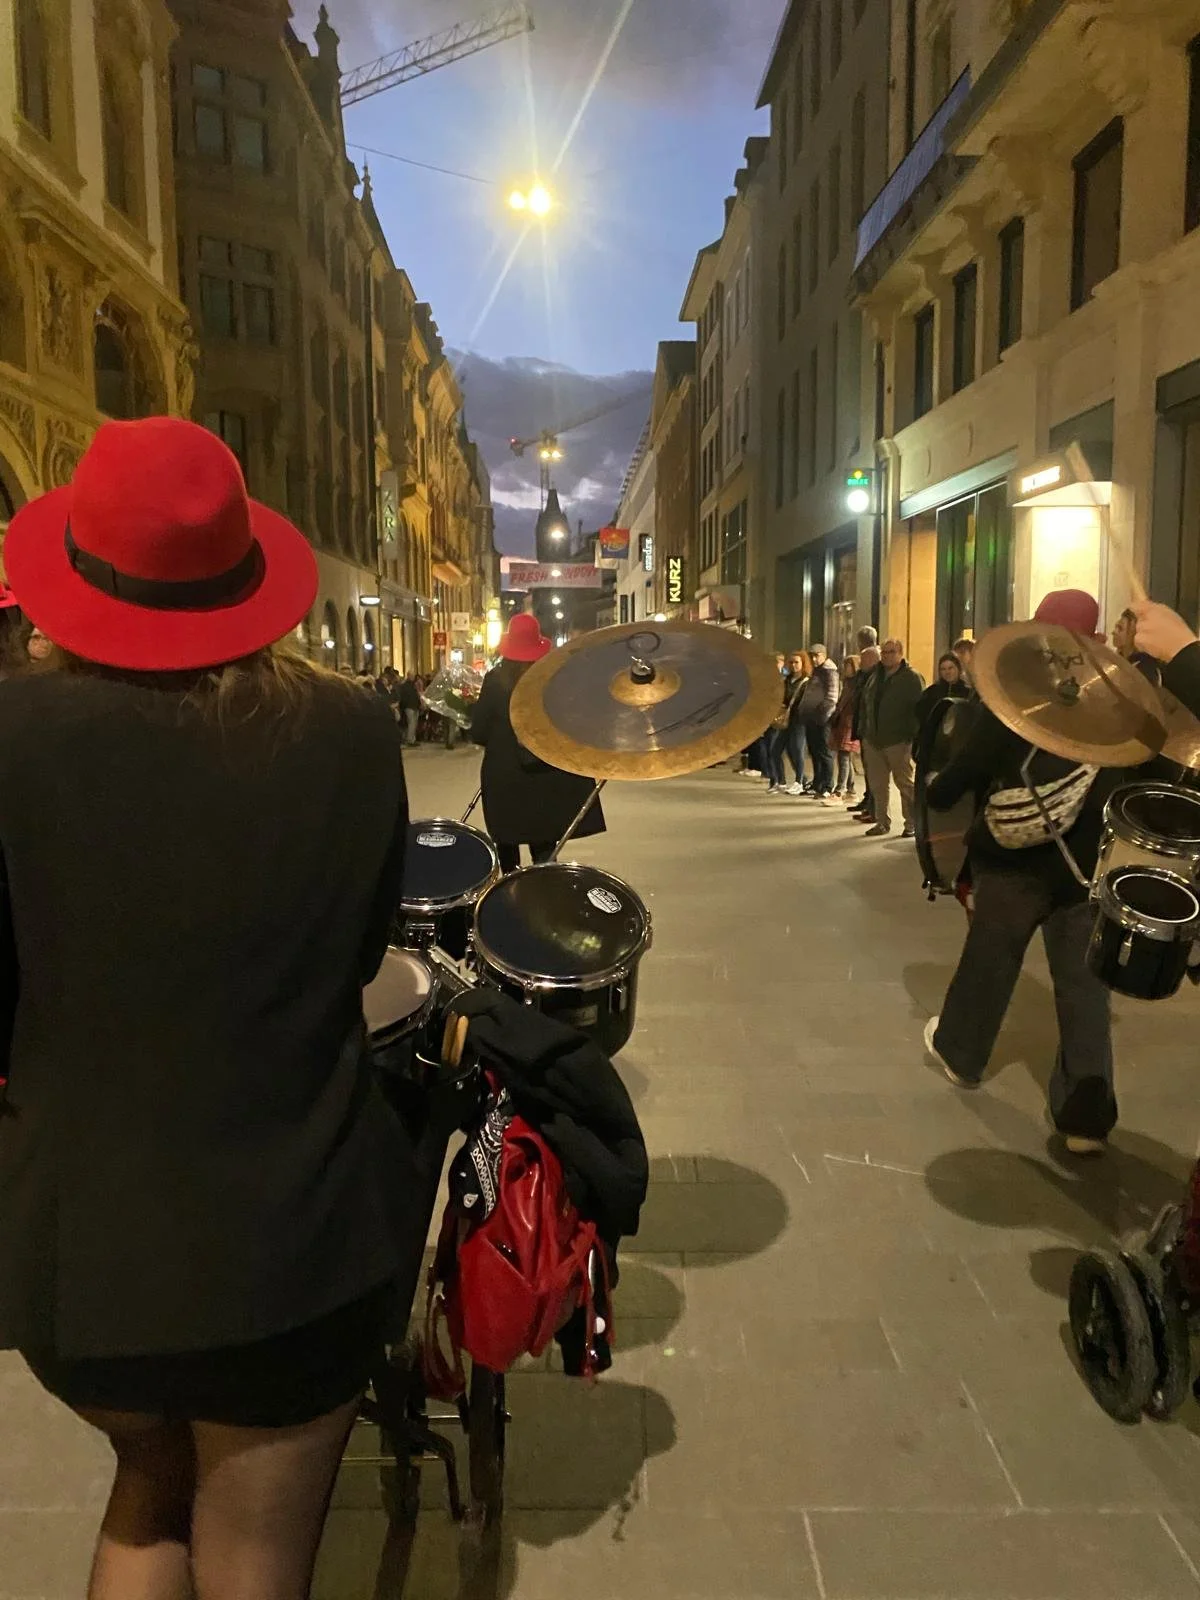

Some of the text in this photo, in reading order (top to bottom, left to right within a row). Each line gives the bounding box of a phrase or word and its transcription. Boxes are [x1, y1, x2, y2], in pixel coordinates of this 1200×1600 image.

[384, 489, 394, 542] ZARA
[511, 569, 546, 584] FRESH
[669, 558, 681, 602] KURZ
